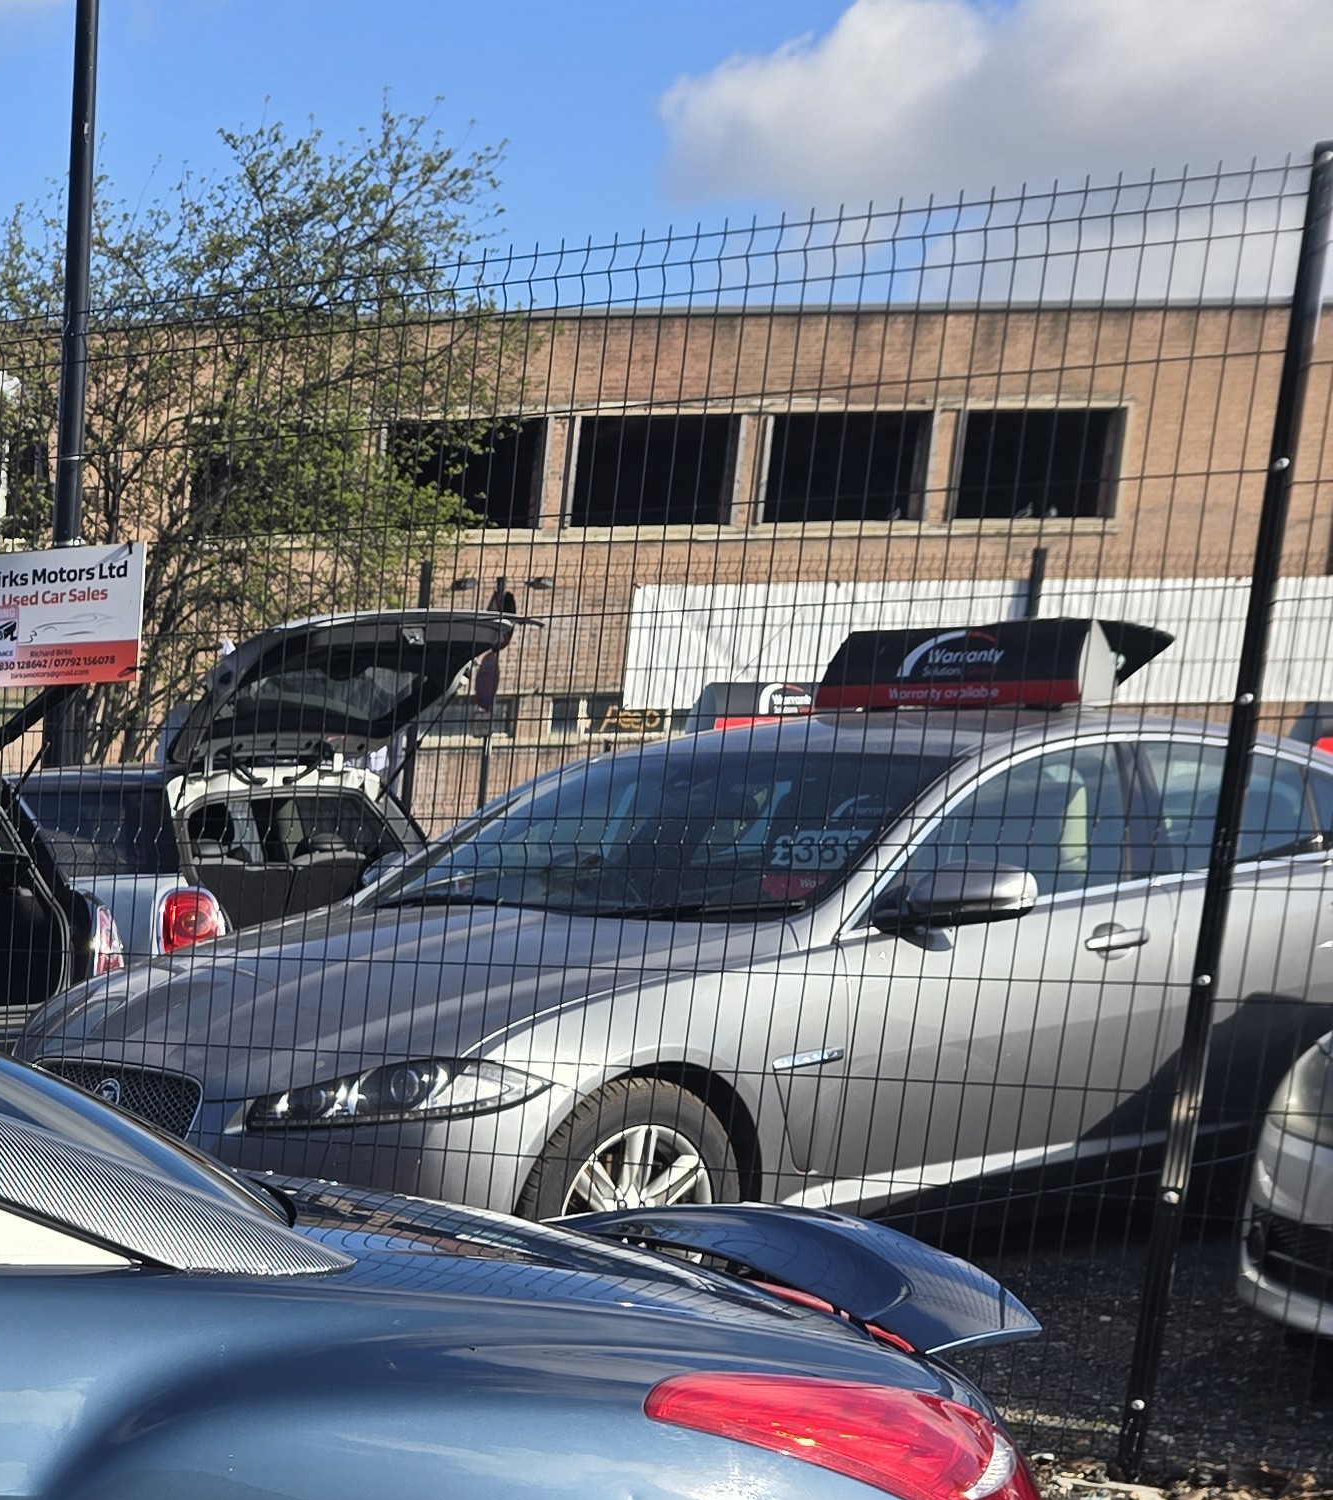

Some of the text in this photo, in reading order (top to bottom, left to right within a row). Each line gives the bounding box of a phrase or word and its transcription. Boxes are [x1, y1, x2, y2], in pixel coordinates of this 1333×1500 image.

[32, 566, 95, 586] Motors
[98, 560, 128, 580] Ltd
[2, 587, 108, 606] Used Car Sales
[30, 648, 73, 658] Richard Birks
[928, 647, 1004, 664] Warranty
[17, 659, 47, 670] 128642
[54, 657, 81, 667] 07792
[83, 655, 115, 665] 156078
[889, 686, 999, 701] Warranty available
